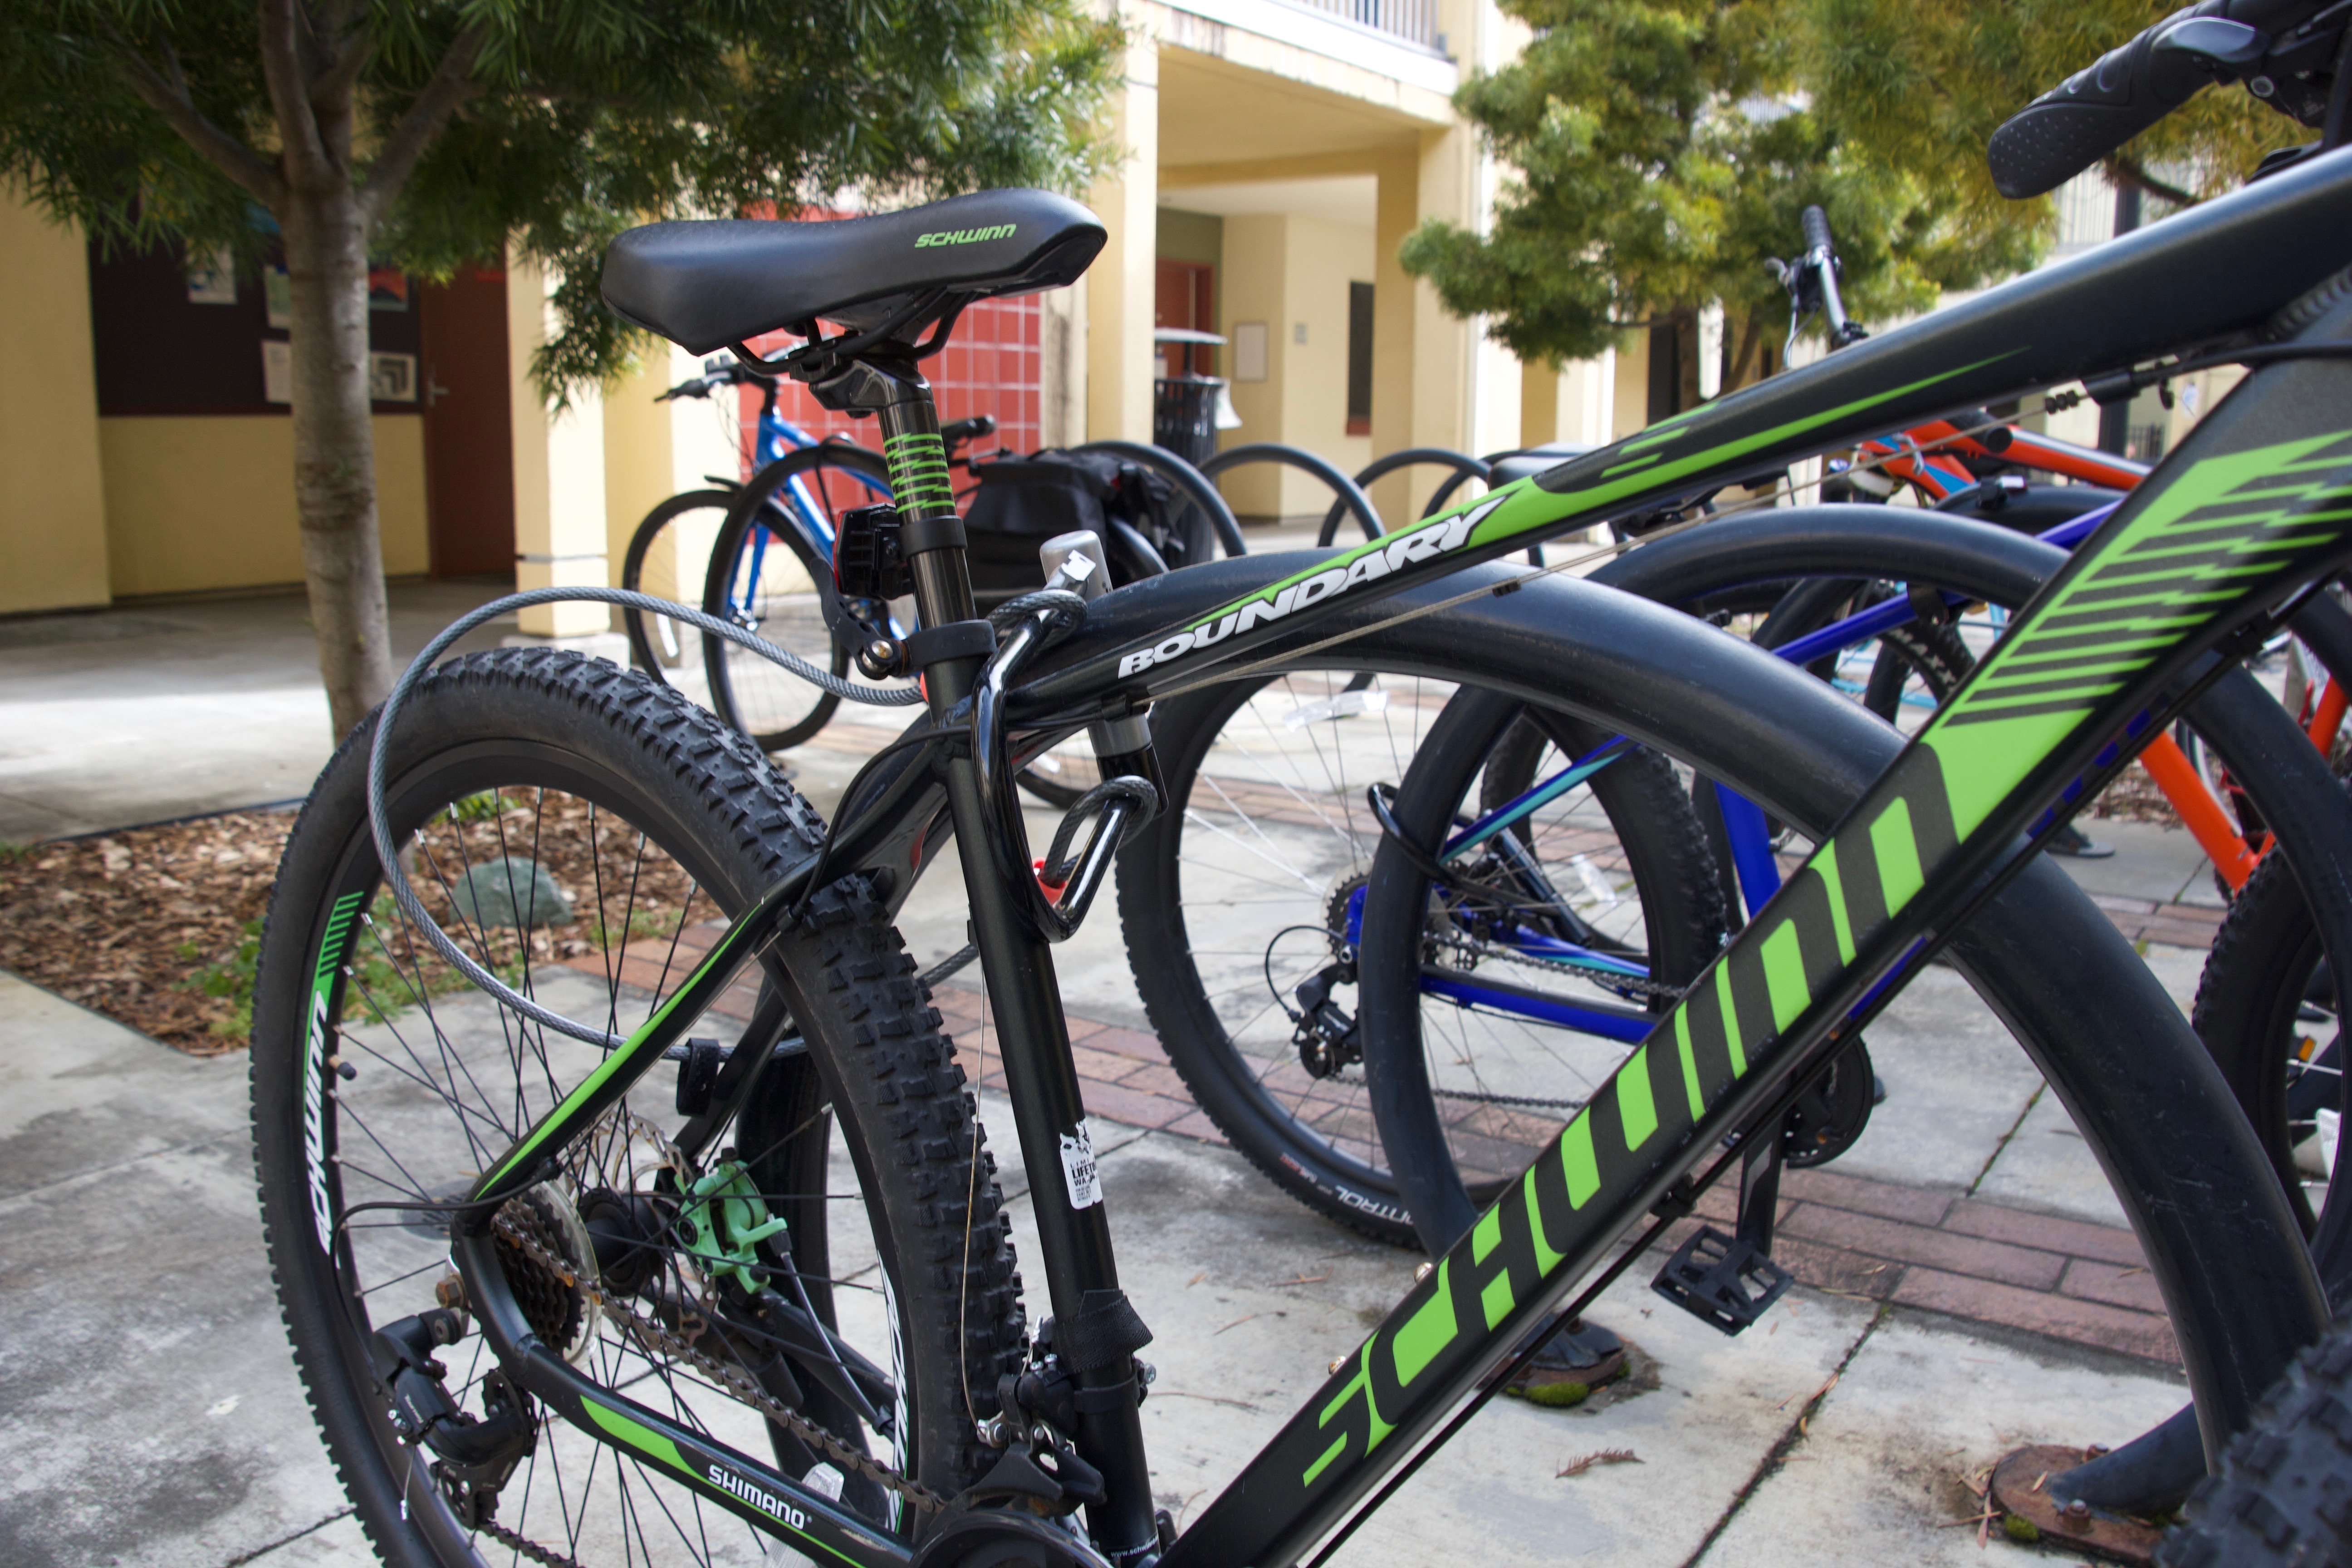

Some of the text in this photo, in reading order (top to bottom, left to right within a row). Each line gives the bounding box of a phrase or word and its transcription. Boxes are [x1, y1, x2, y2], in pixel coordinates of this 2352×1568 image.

[914, 223, 1017, 248] SCHWINN
[1117, 495, 1506, 679] BOUNDARY
[1298, 740, 1962, 1493] SCHWINN
[708, 1464, 805, 1530] SHIMANO
